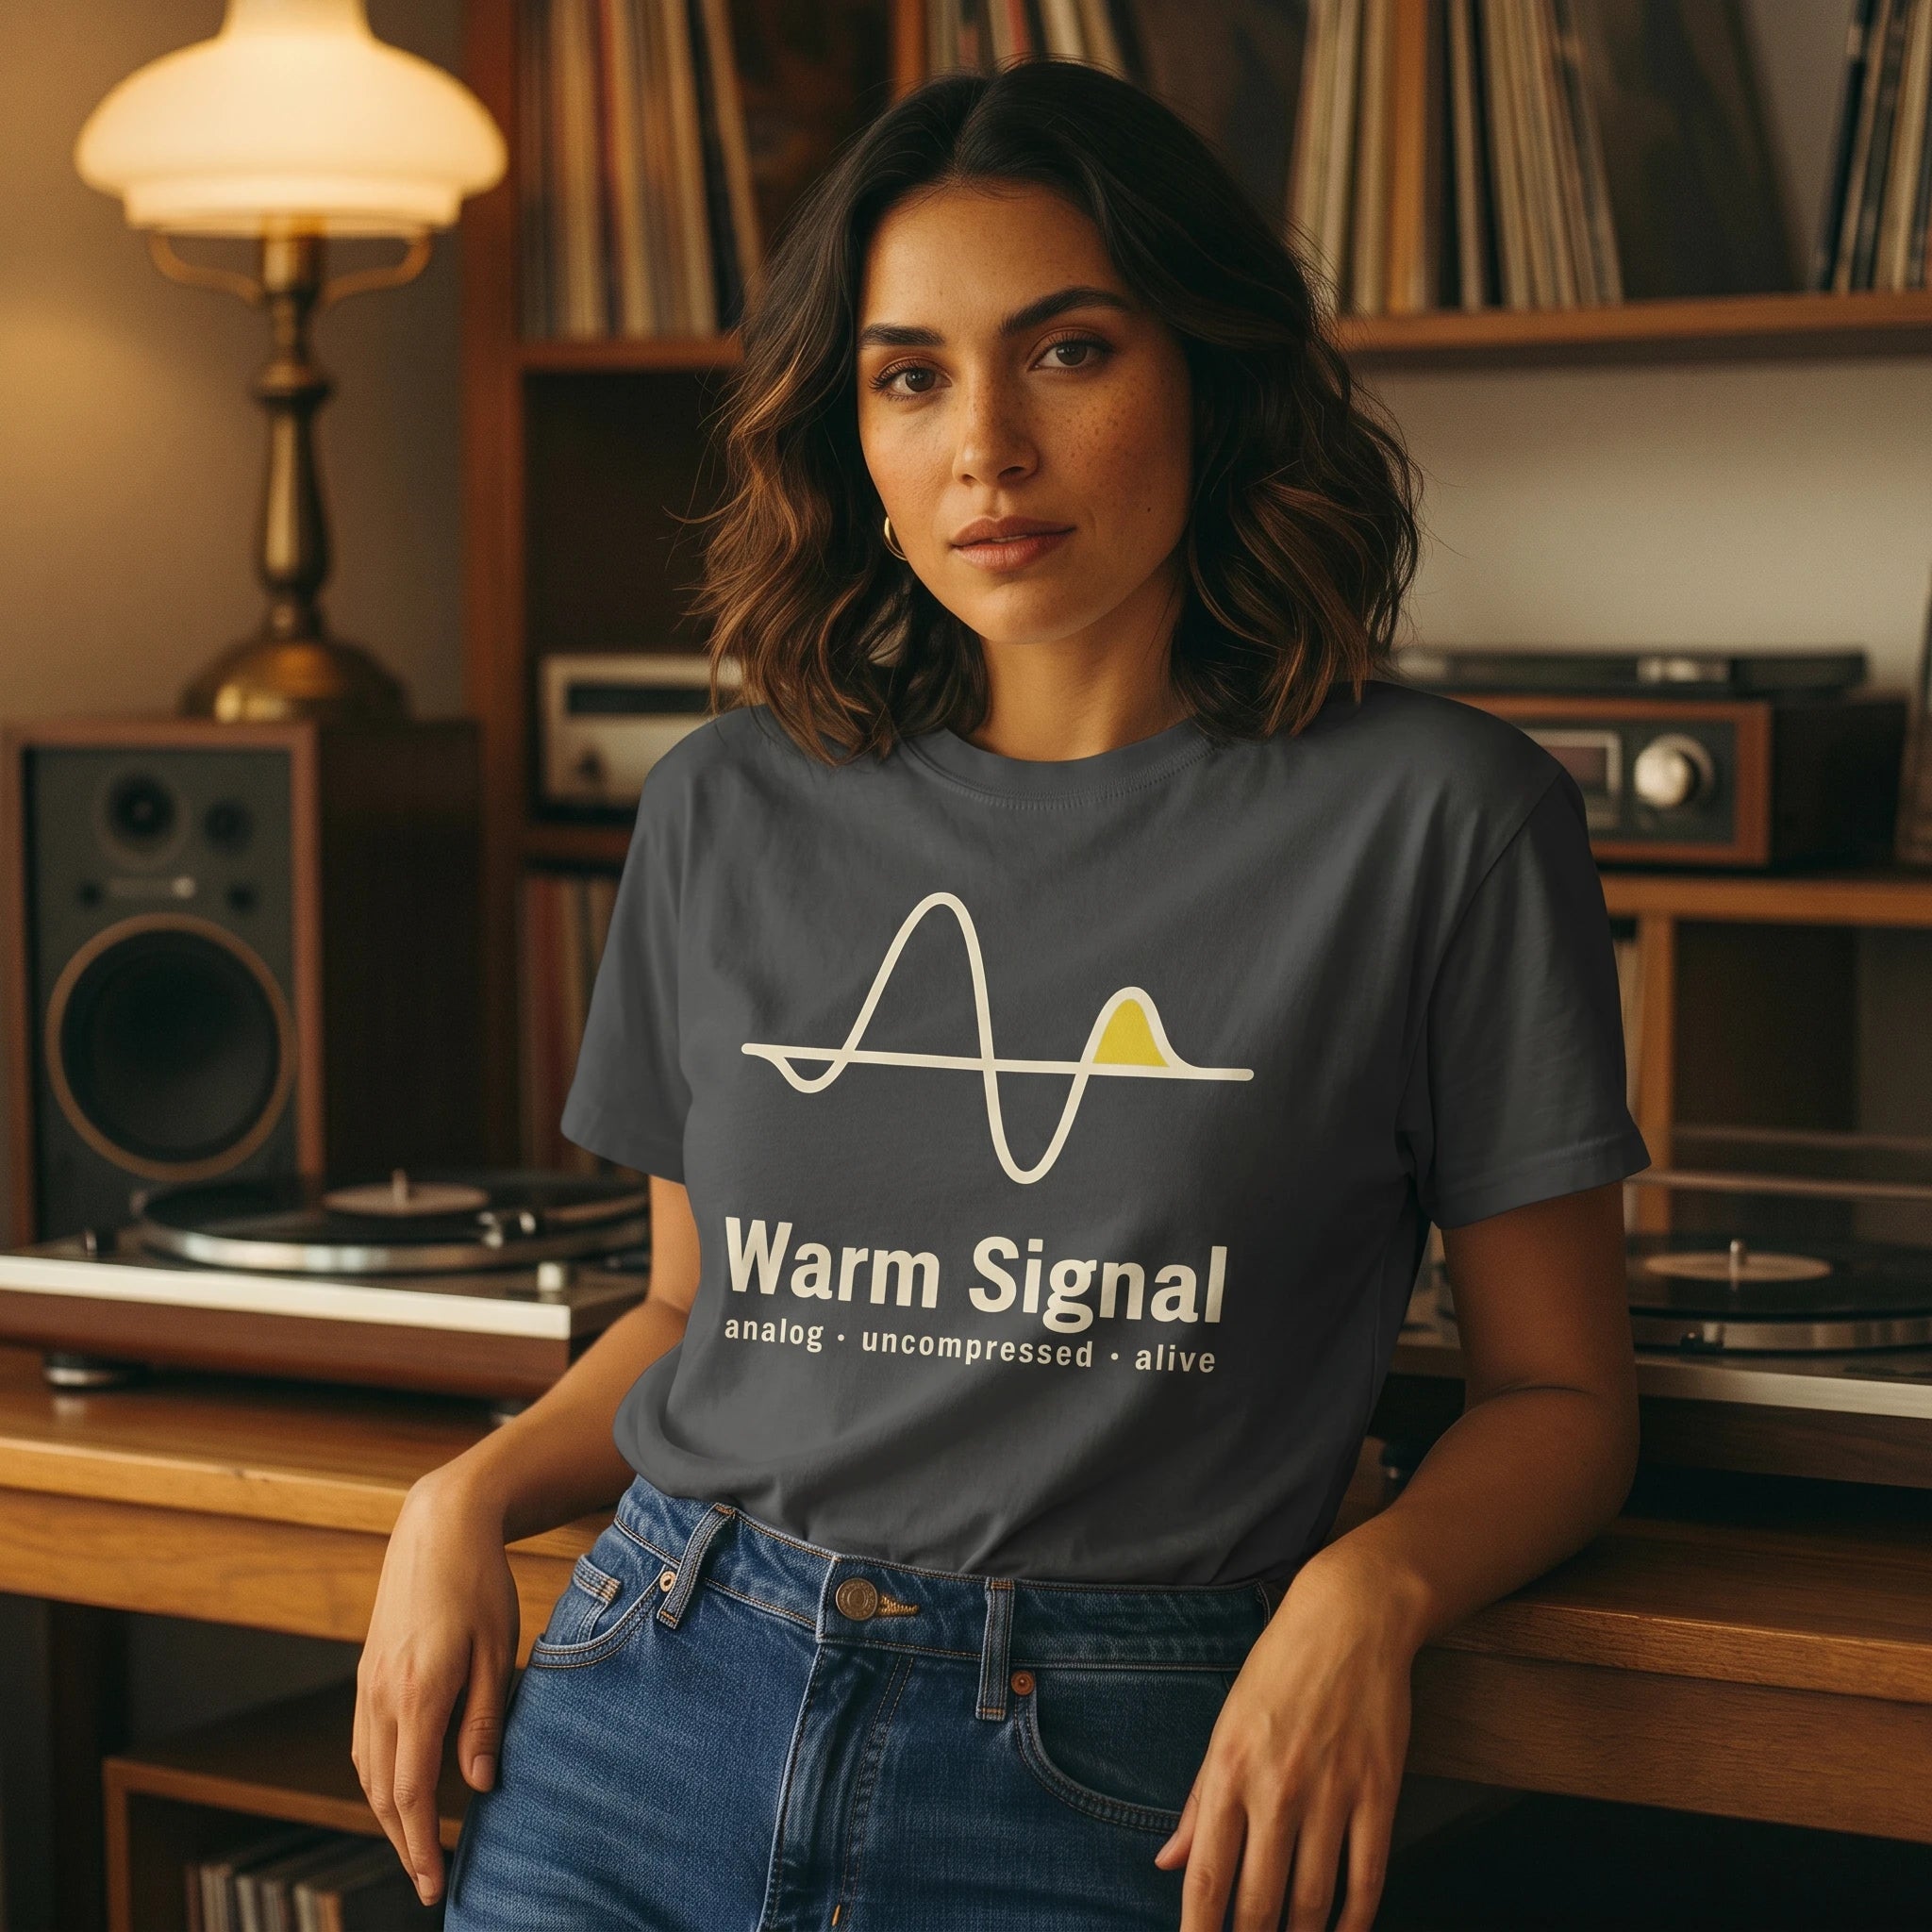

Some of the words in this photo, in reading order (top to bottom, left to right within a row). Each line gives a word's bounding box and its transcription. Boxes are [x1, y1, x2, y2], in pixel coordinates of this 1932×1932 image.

[724, 1216, 941, 1309] Warm
[968, 1236, 1227, 1334] Signal
[724, 1317, 824, 1354] analog
[862, 1331, 1093, 1368] uncompressed
[1135, 1343, 1215, 1373] alive
